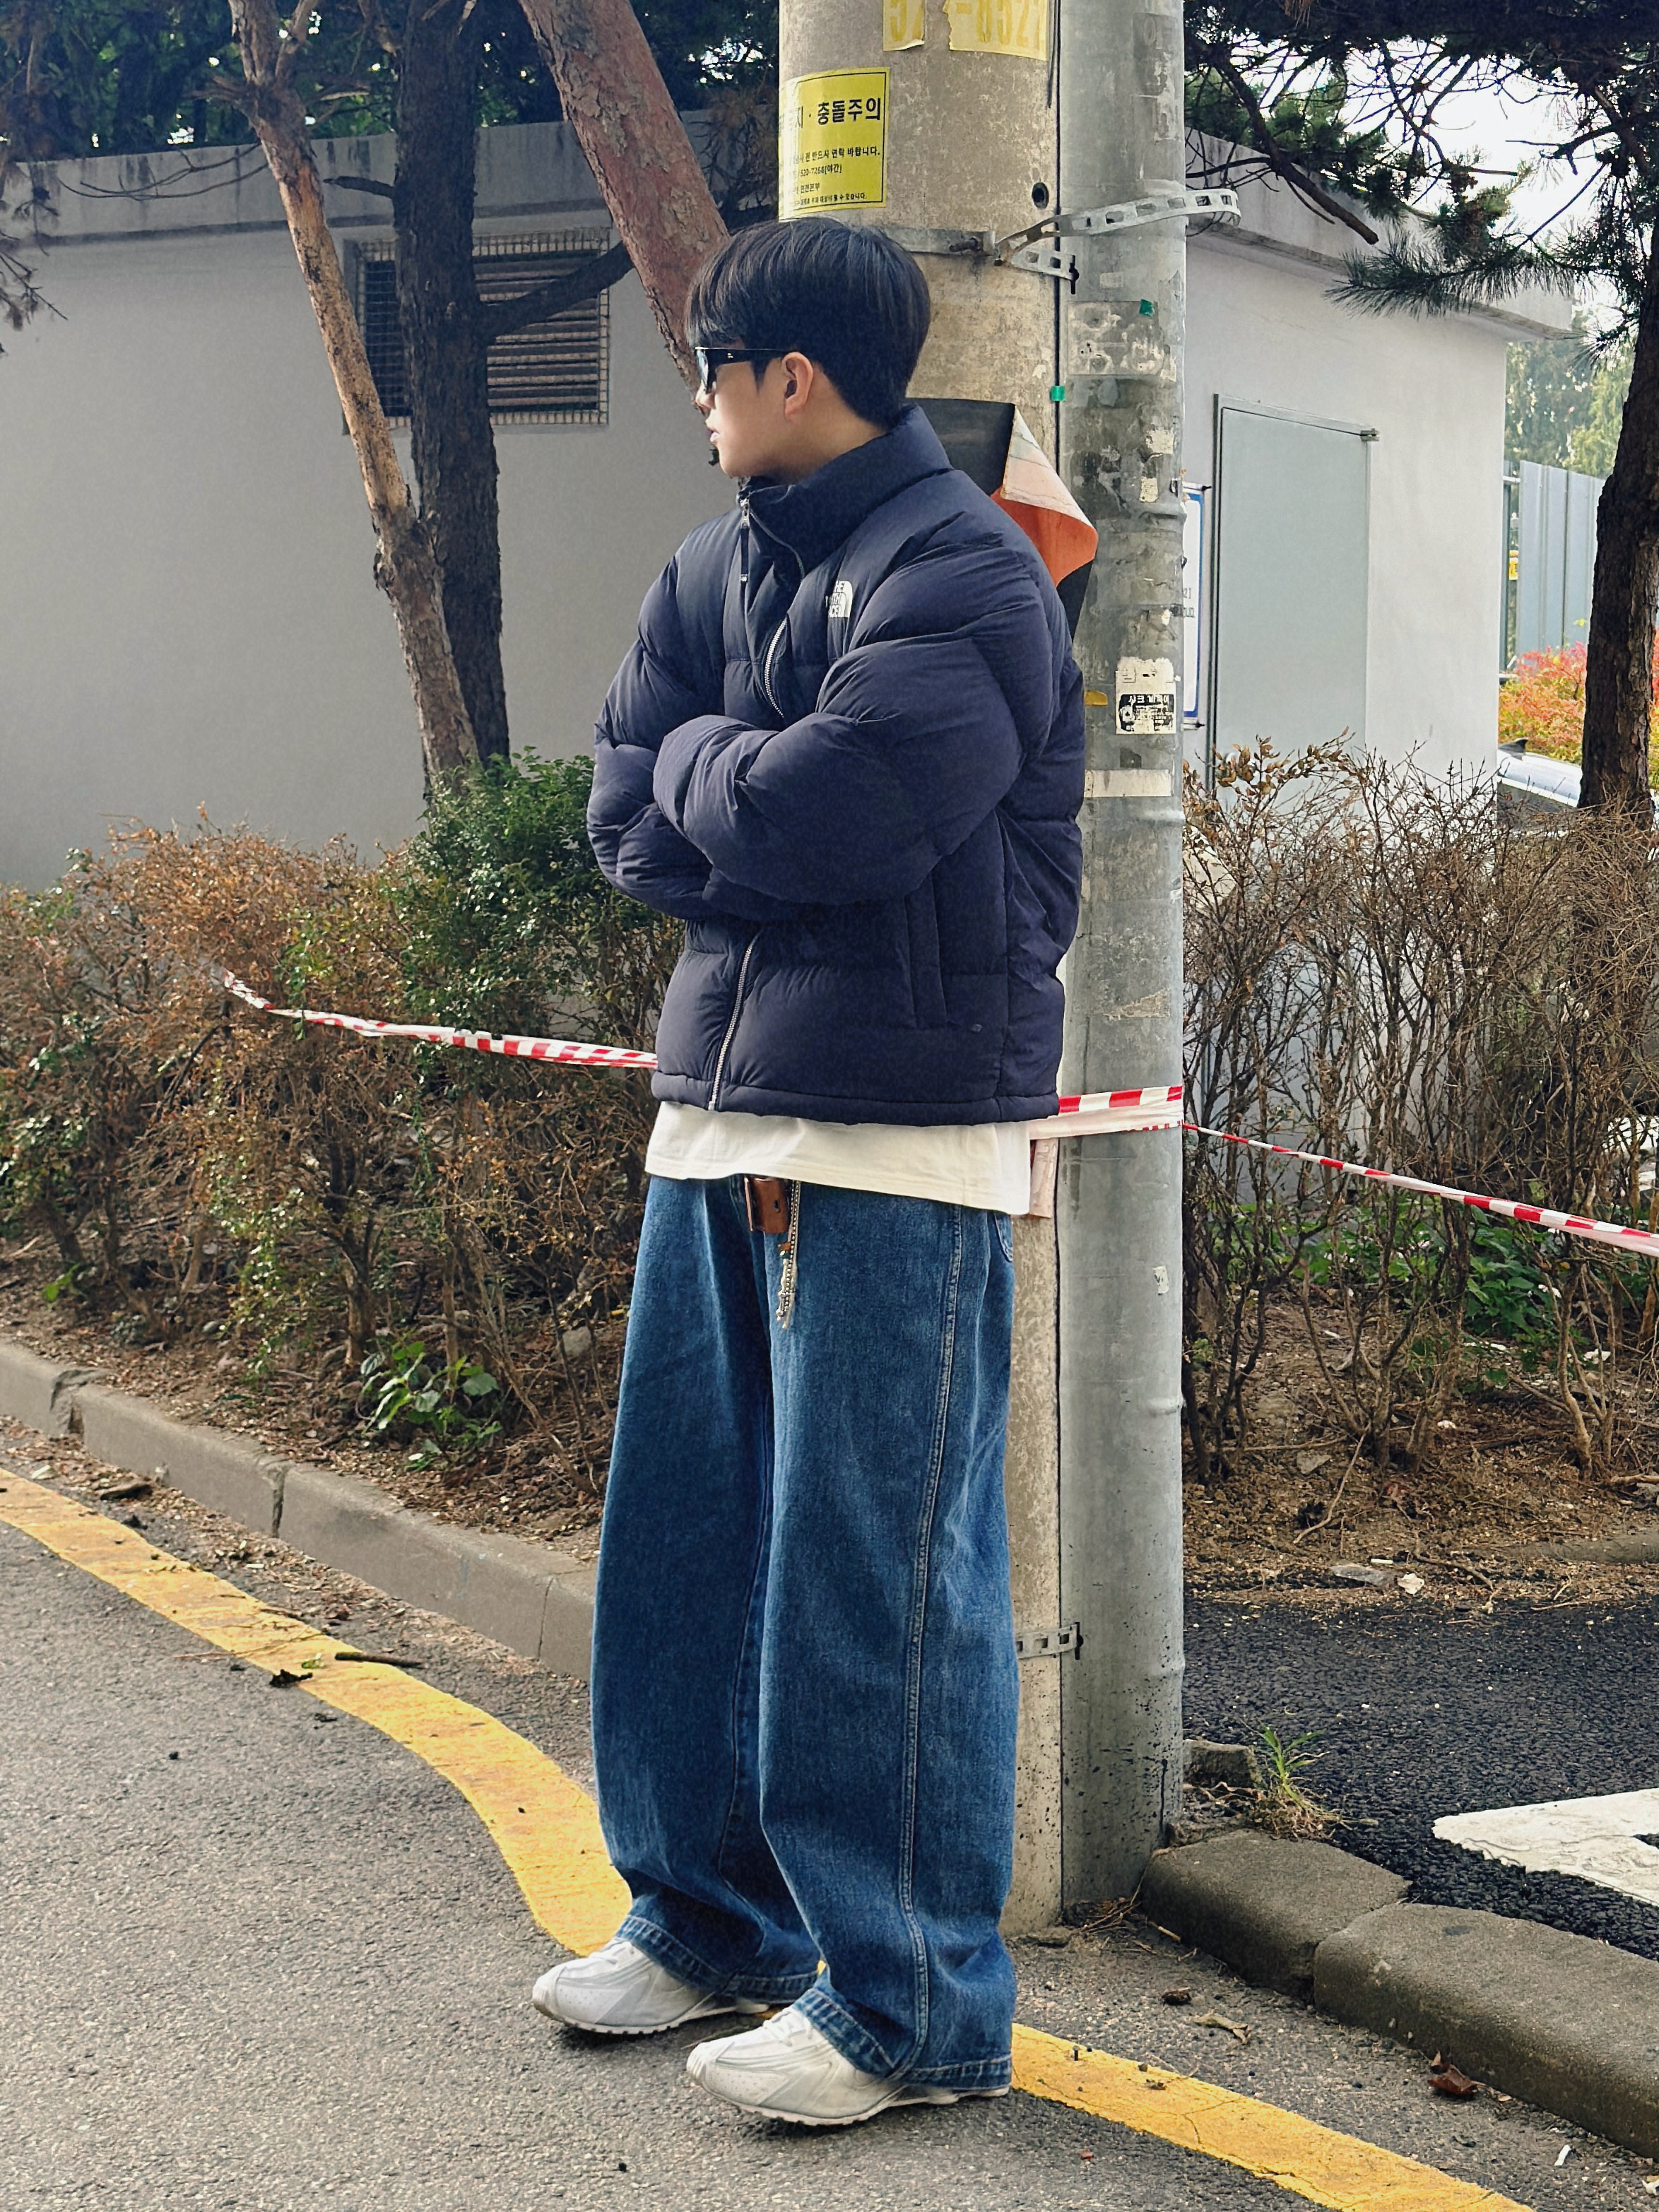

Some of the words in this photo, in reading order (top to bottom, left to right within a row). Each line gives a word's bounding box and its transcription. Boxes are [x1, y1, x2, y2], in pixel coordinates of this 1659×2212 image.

[817, 97, 881, 126] 충돌주의
[812, 149, 830, 161] 반드시
[831, 148, 846, 159] 연락
[847, 146, 881, 157] 바랍니다.
